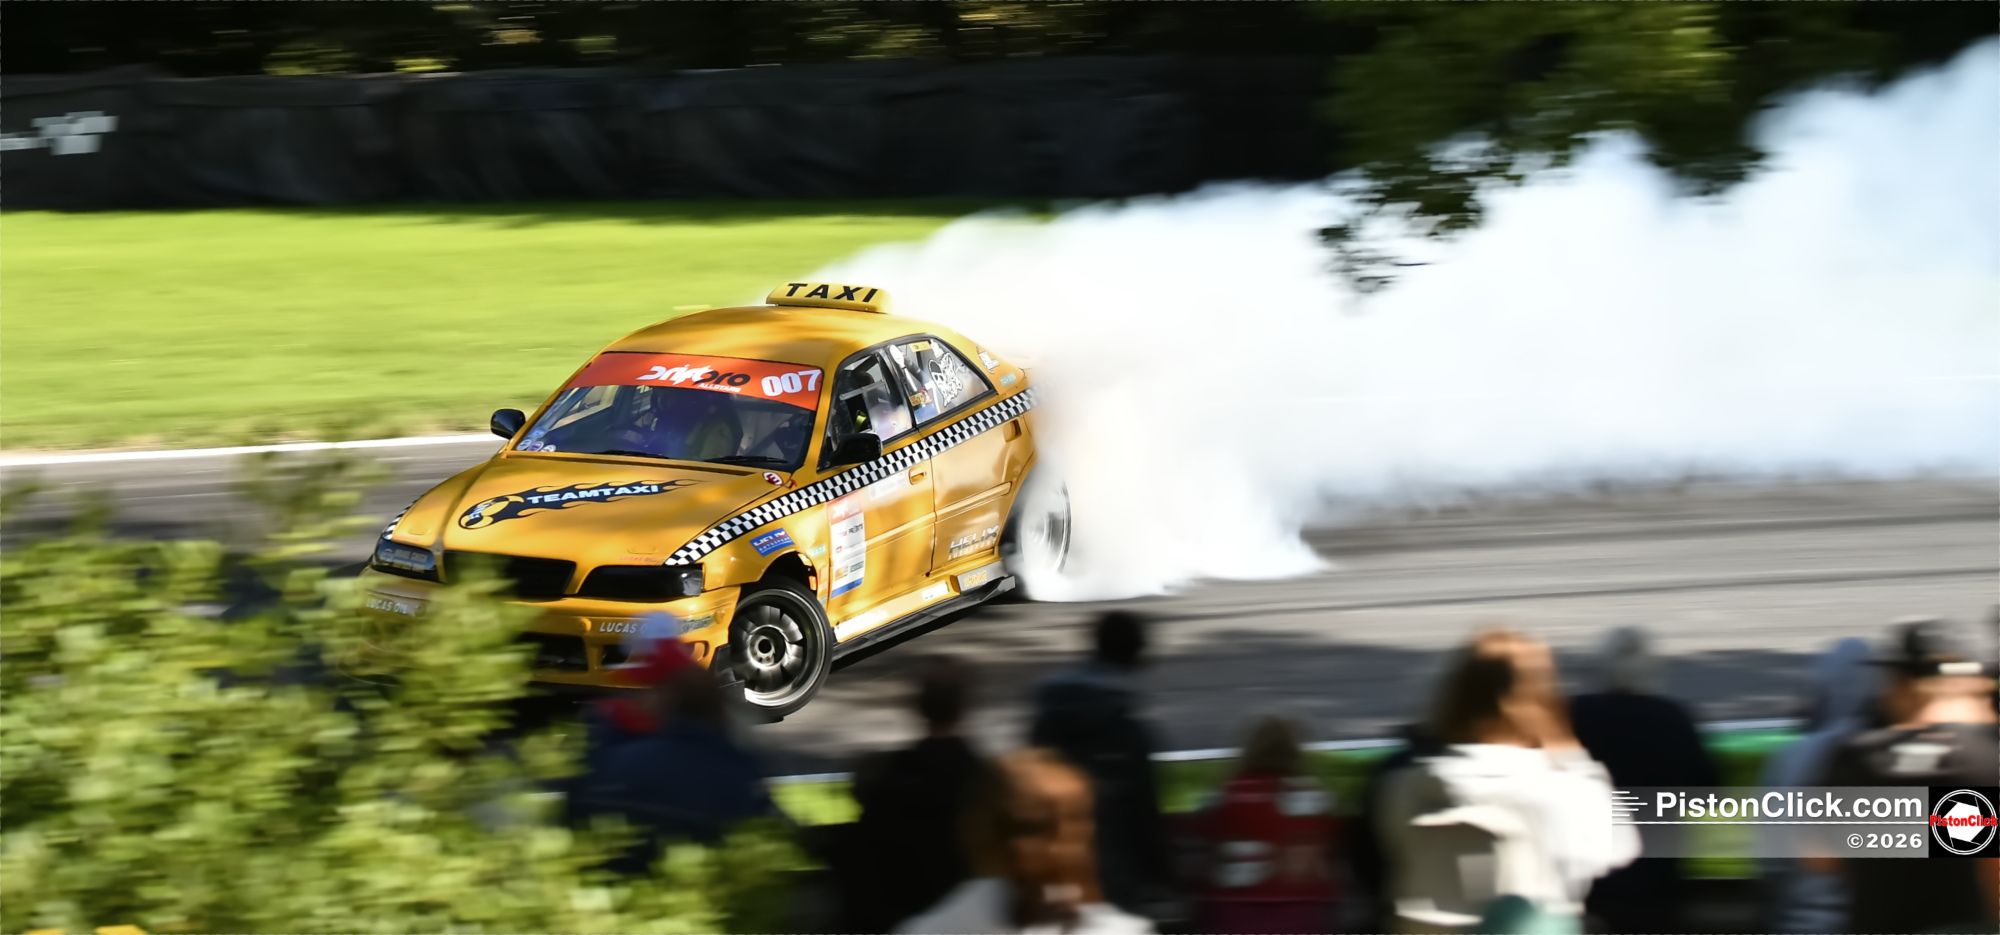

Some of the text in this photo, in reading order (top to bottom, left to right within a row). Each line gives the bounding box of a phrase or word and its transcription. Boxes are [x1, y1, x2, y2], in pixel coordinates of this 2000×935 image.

[786, 283, 878, 303] TAXI
[698, 382, 742, 393] ALLSTARS
[761, 369, 822, 397] 007
[527, 484, 659, 504] TEAMTAXI
[949, 525, 999, 553] HELIX
[366, 598, 409, 615] LUCAS OIL
[599, 622, 638, 634] LUCAS
